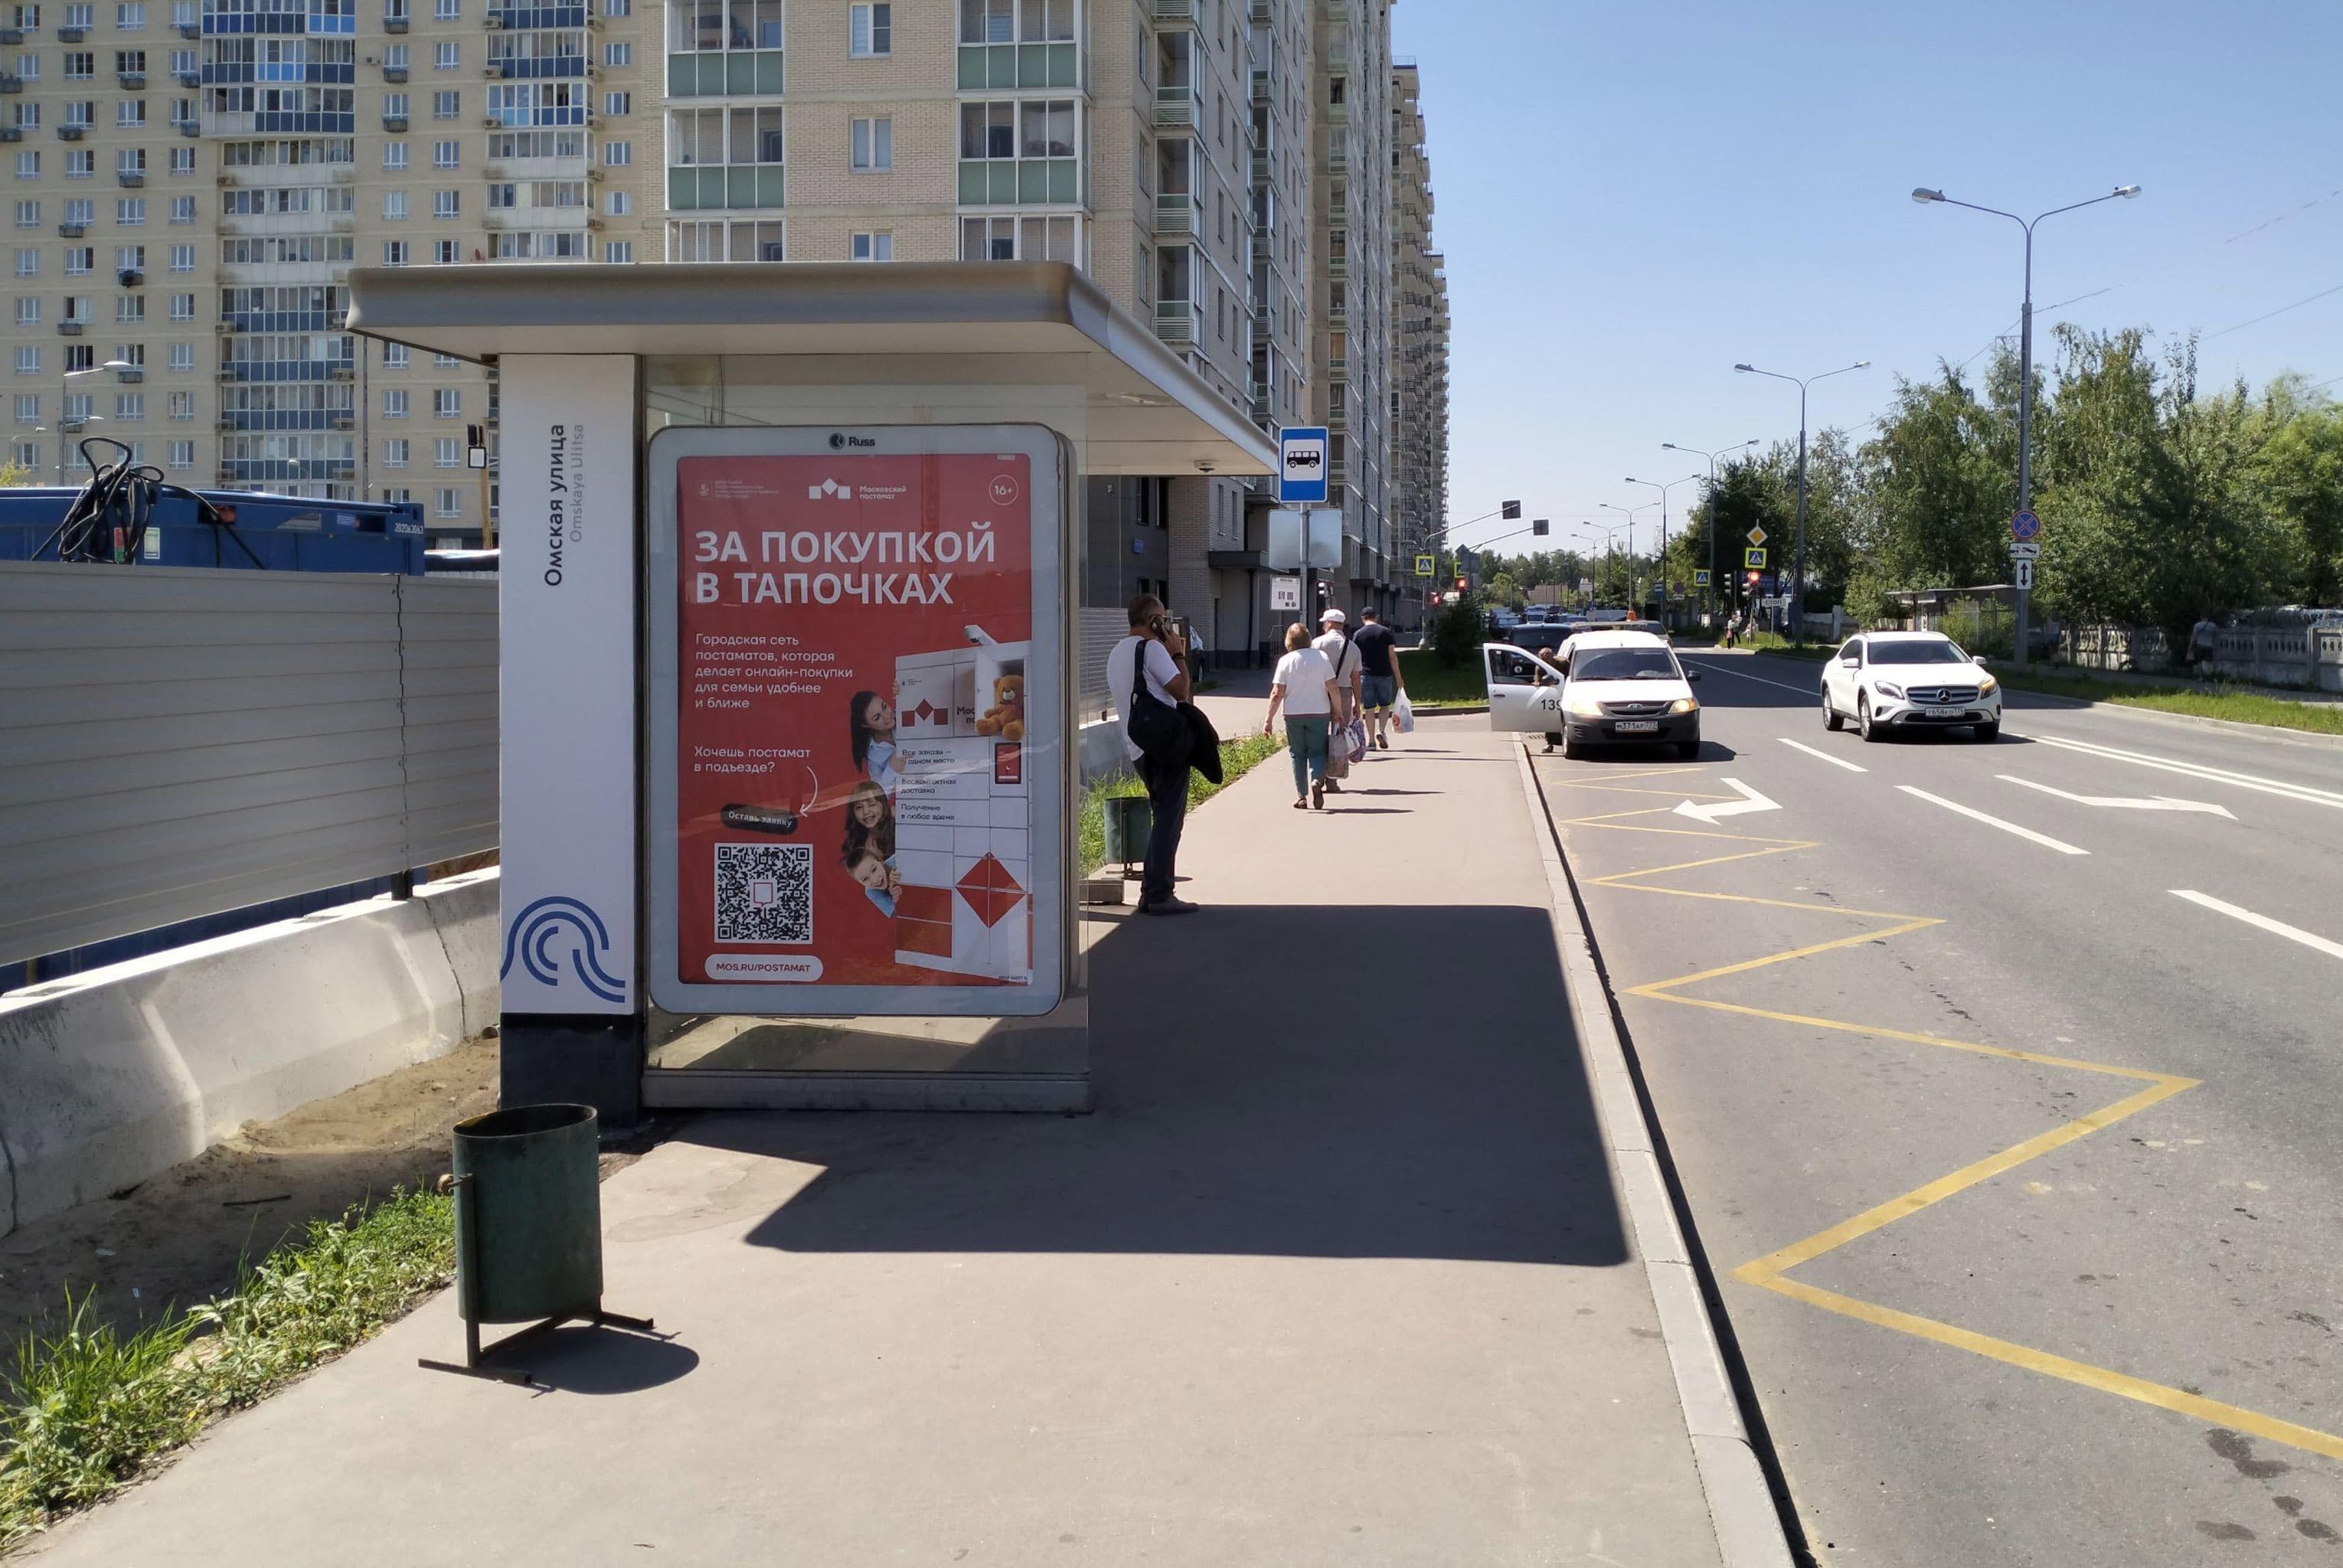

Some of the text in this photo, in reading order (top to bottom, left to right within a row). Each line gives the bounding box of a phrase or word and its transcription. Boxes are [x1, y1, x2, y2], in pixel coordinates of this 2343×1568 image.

[848, 436, 876, 447] Russ
[570, 424, 586, 542] Omskaya Ulitsa
[859, 485, 907, 494] Московский
[995, 485, 1013, 495] 16+
[544, 424, 567, 586] Омская улица
[694, 521, 995, 564] ЗА ПОКУПКОЙ
[696, 572, 954, 605] В ТАПОЧКАХ
[695, 633, 799, 647] Городская сеть
[695, 651, 835, 664] постаматов, которая
[694, 666, 853, 680] делает онлайн-покупки
[694, 681, 822, 695] для семьи удобнее
[695, 697, 750, 709] и ближе
[694, 746, 812, 758] Хочешь постамат
[694, 761, 776, 774] в подъезде?
[900, 803, 941, 812] Получение
[728, 810, 793, 828] Оставь заявку
[716, 963, 811, 973] MOS.RU/POSTAMAT
